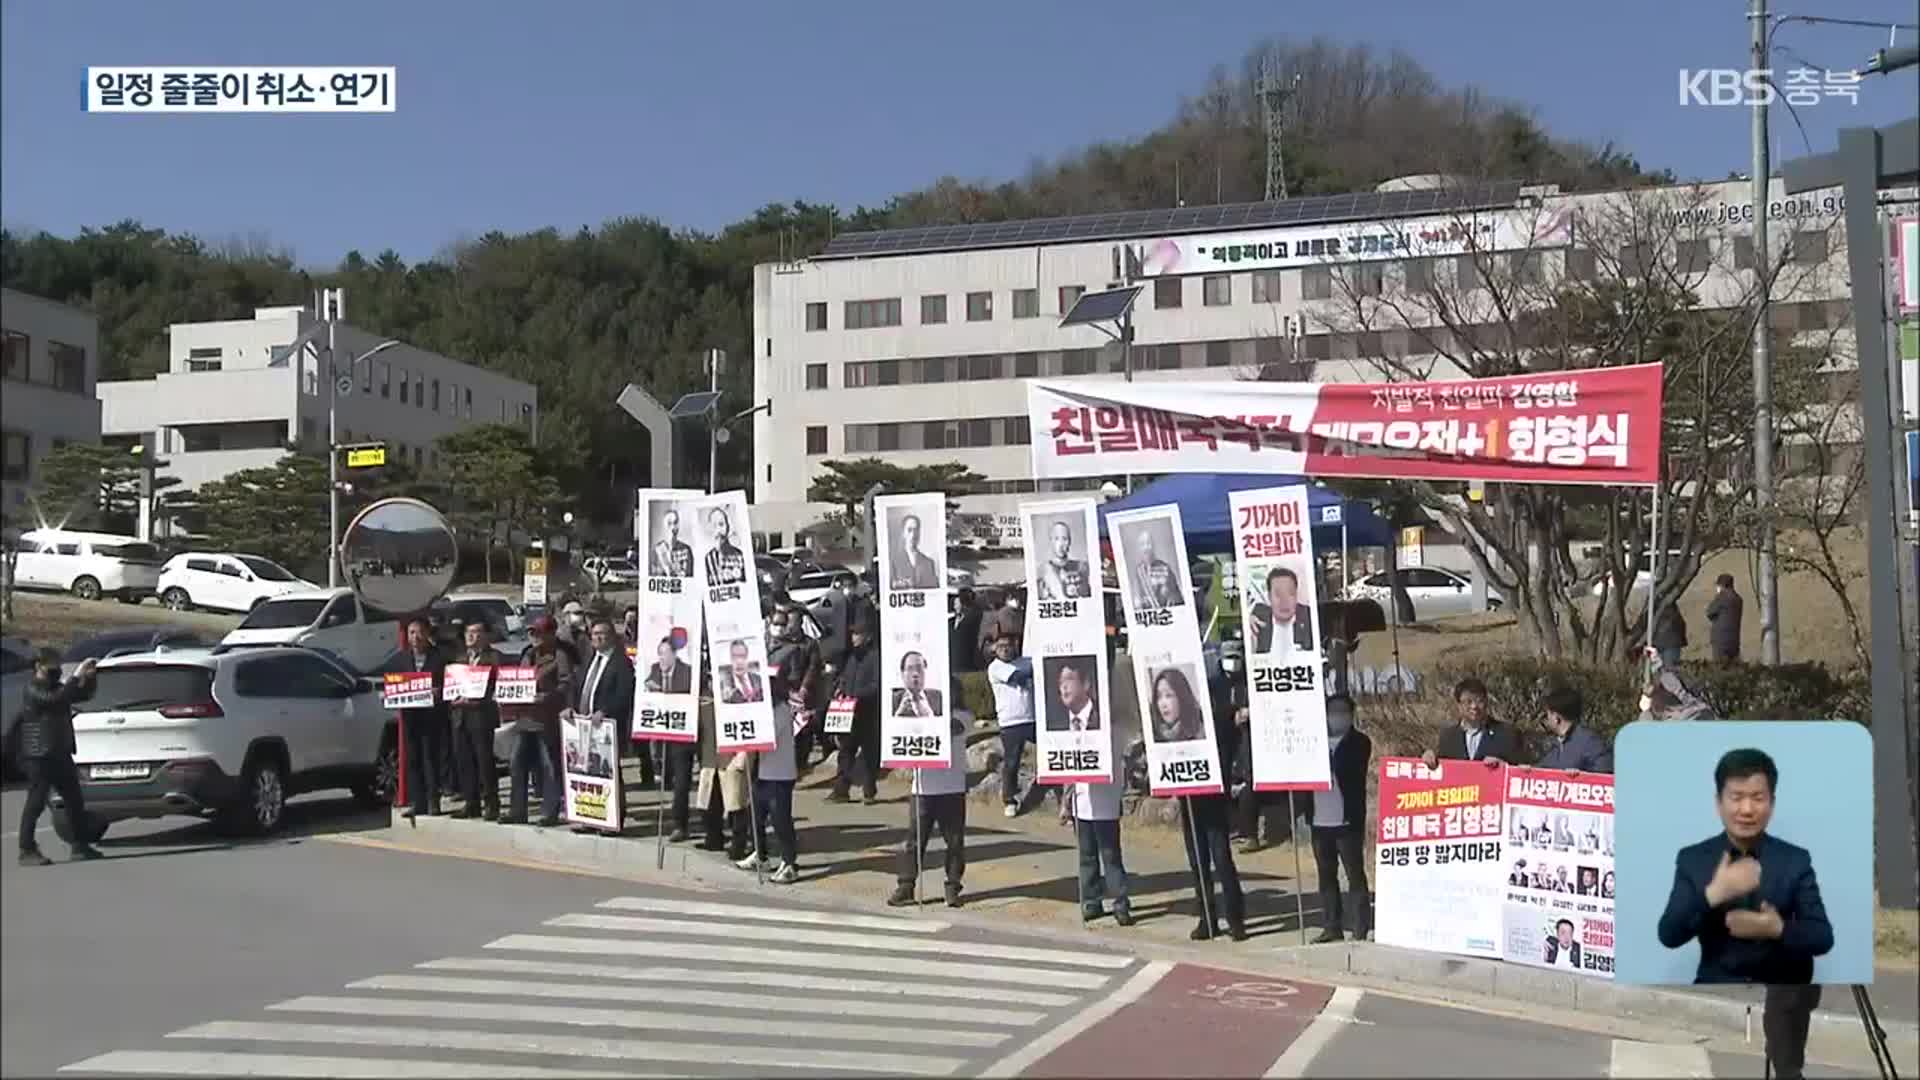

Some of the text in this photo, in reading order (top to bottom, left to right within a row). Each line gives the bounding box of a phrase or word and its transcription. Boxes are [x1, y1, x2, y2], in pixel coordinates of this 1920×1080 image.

[1440, 383, 1504, 411] 친일파
[1509, 380, 1579, 409] 김영환
[1508, 413, 1629, 467] 화형식
[1238, 501, 1301, 530] 기꺼이
[1242, 530, 1304, 559] 친일파
[889, 592, 925, 609] 이지용
[1038, 601, 1078, 619] 권중현
[1253, 665, 1316, 692] 김영환
[640, 709, 686, 730] 윤석열
[892, 736, 942, 757] 김성한
[1047, 749, 1101, 771] 김태효
[1160, 759, 1211, 784] 서민정
[1397, 791, 1434, 810] 기꺼이
[1382, 804, 1501, 839] 친일 매국 김영환
[1381, 846, 1410, 866] 의병
[1415, 847, 1430, 866] 땅
[1434, 842, 1501, 864] 밟지마라
[1583, 918, 1613, 934] 기꺼이
